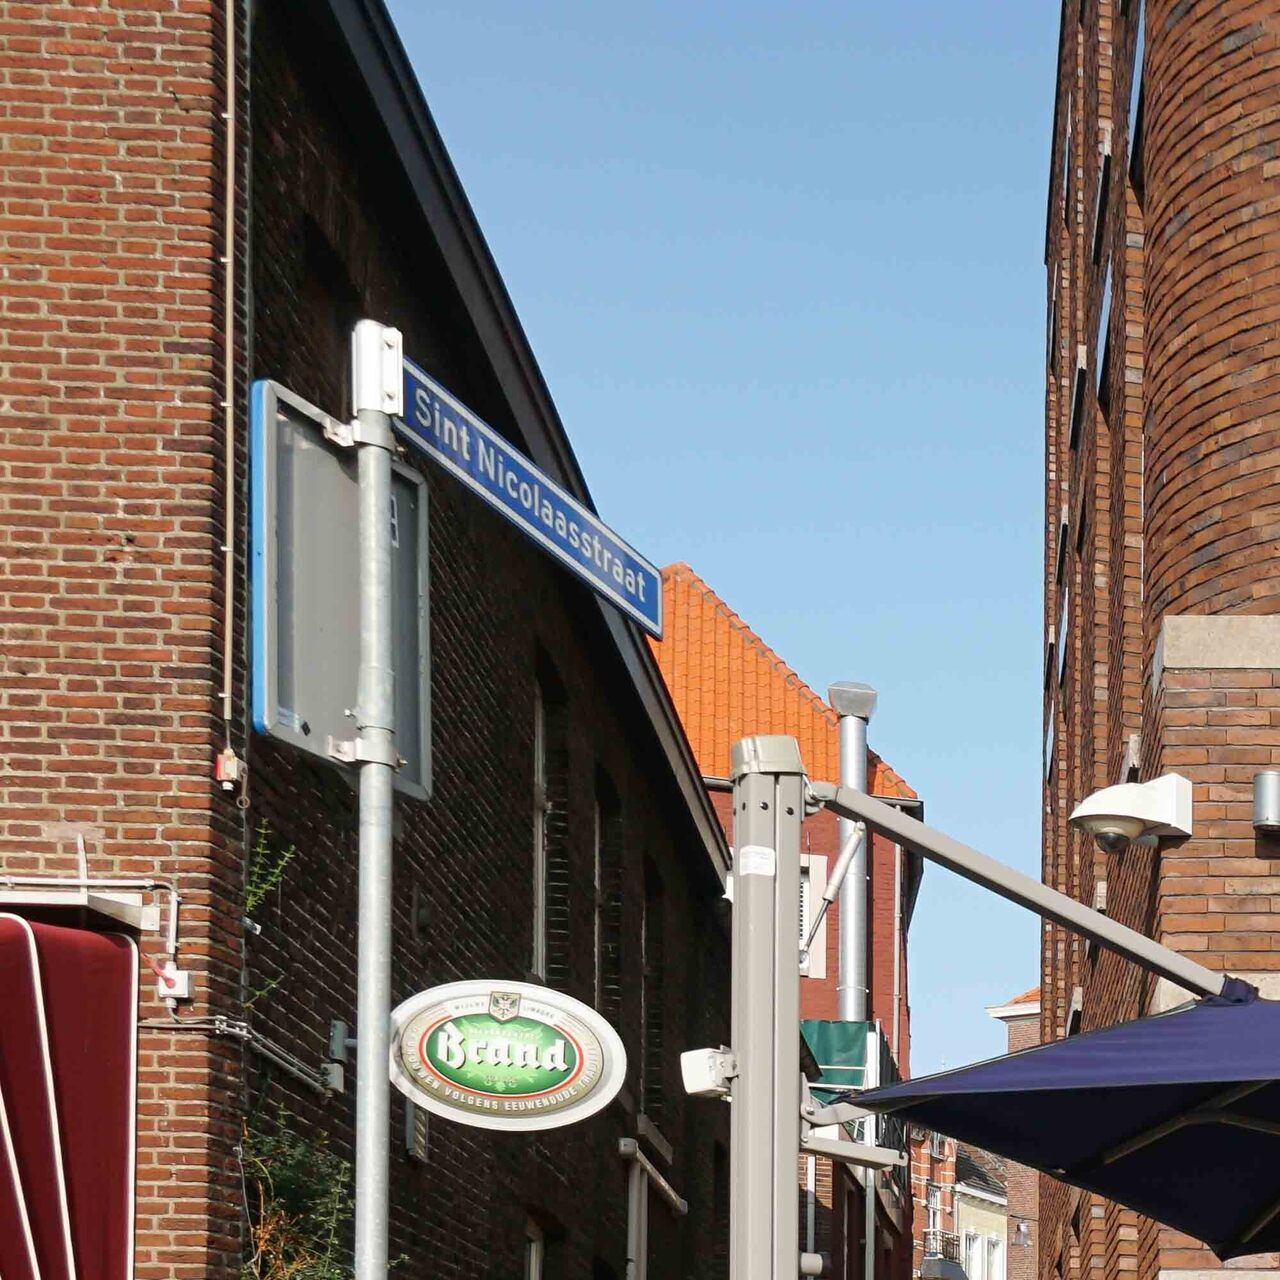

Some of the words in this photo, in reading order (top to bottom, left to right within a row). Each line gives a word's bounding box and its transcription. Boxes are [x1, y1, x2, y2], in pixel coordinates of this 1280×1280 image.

[414, 387, 471, 462] Sint
[476, 438, 647, 603] Nicolaasstraat
[437, 1021, 570, 1070] Brand
[444, 1088, 498, 1110] VOLGENS
[504, 1087, 577, 1111] EEUWENOUDE
